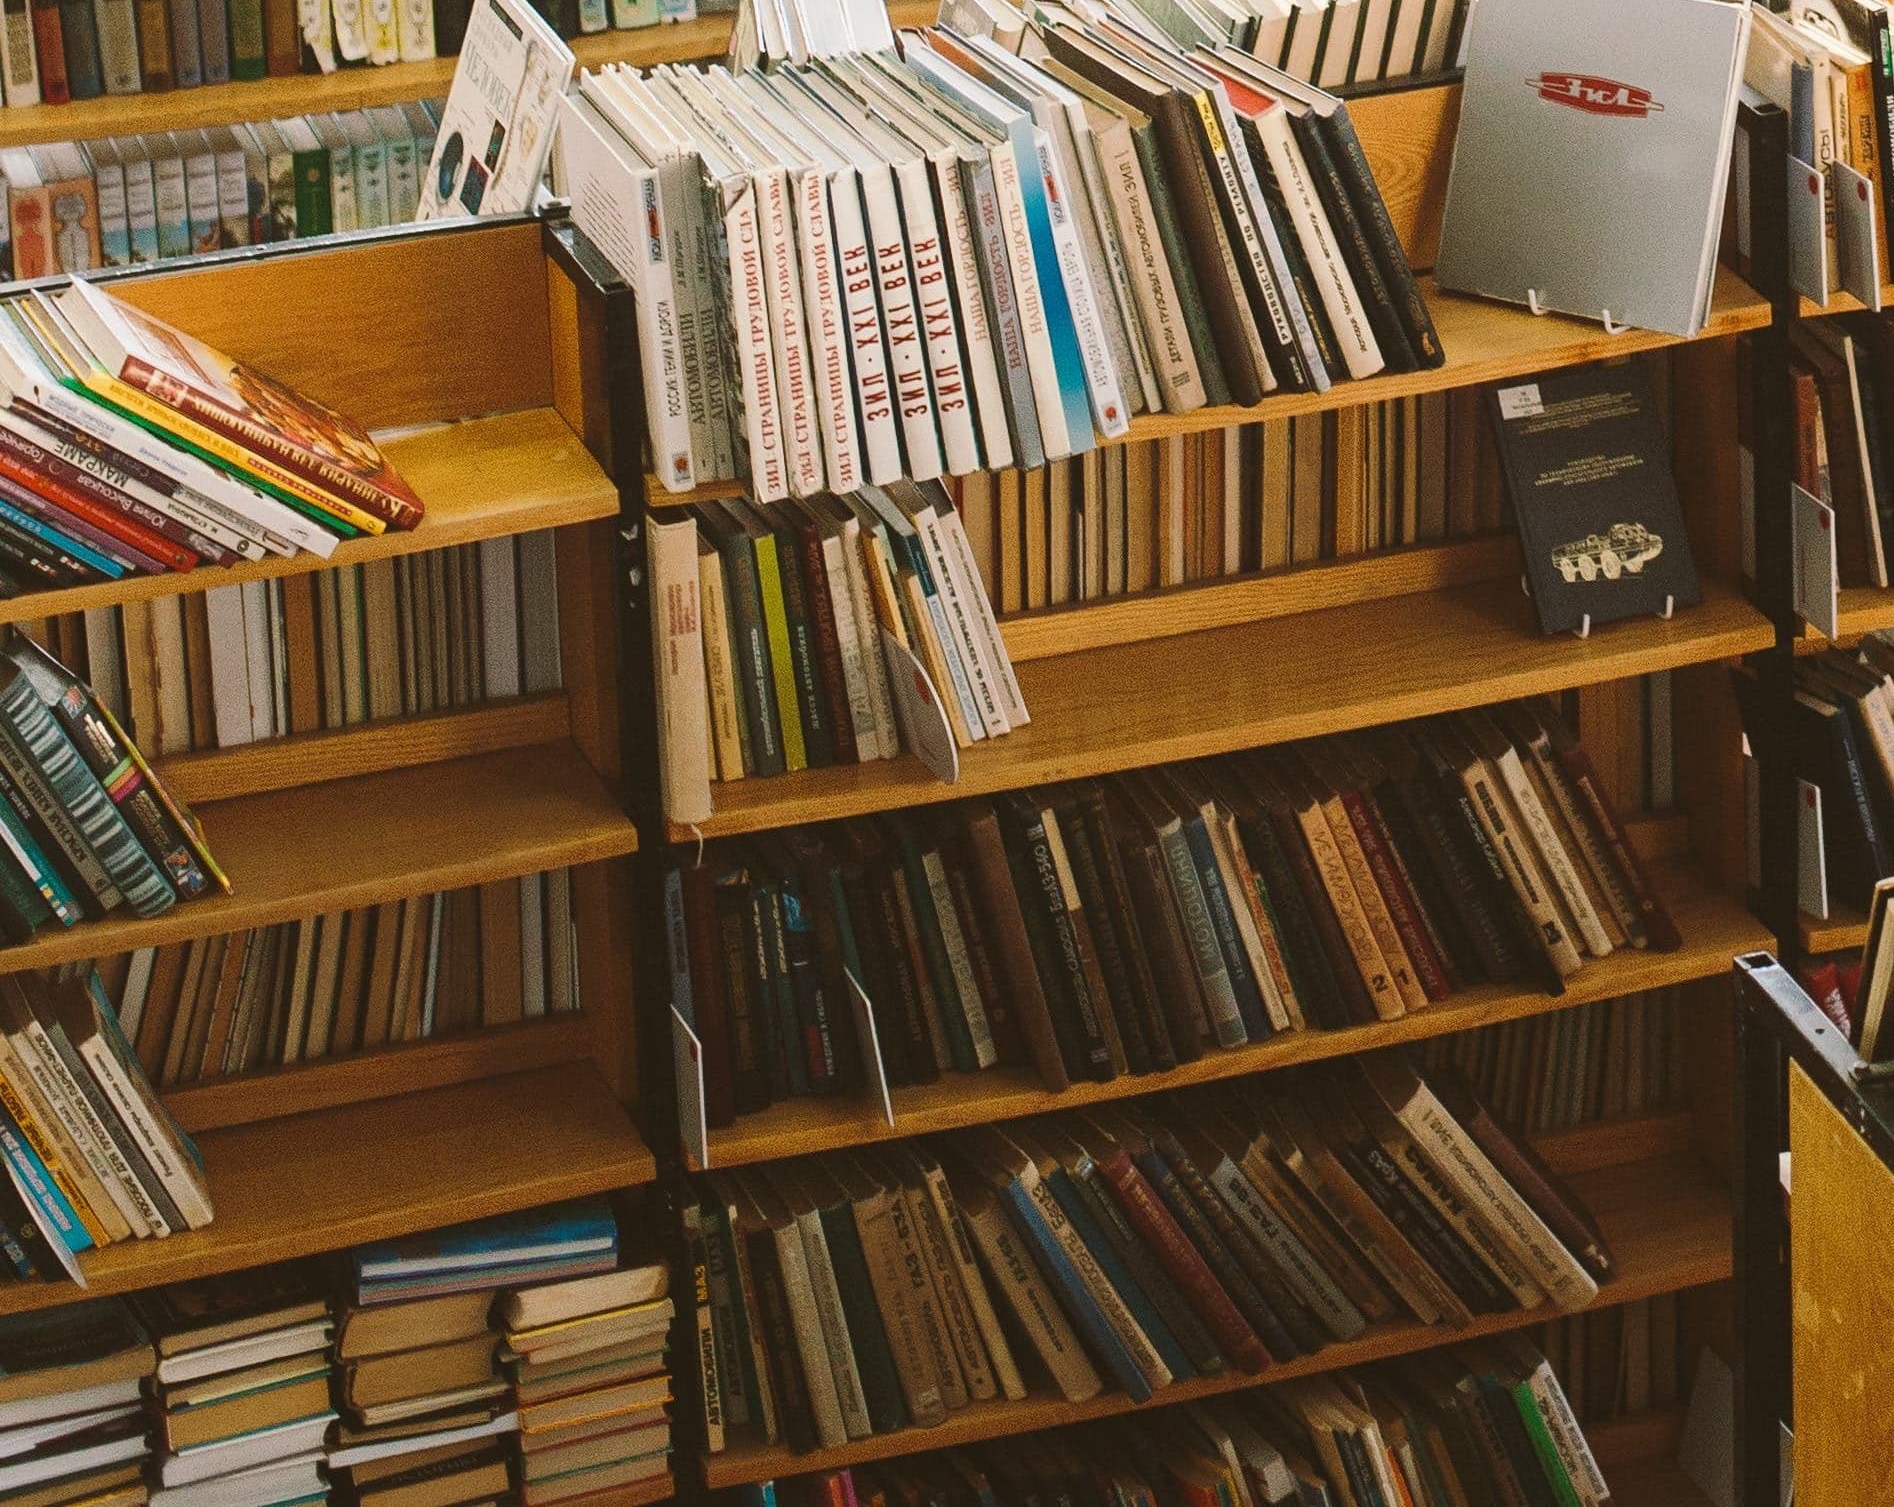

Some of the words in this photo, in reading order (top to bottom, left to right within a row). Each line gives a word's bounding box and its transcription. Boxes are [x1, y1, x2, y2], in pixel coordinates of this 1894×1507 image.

[1118, 161, 1137, 192] ЗИЛ
[1217, 154, 1245, 215] РЕМОНТУ
[806, 174, 825, 237] СЛАВЫ
[1127, 195, 1156, 268] АВТОМОБИЛЕЙ
[842, 245, 871, 291] ВЕК
[877, 242, 906, 288] ВЕК
[913, 238, 942, 284] ВЕК
[954, 209, 979, 289] ГОРДОСТЬ
[1006, 202, 1033, 281] ГОРДОСТЬ
[741, 249, 766, 347] ТРУДОВОЙ
[772, 242, 799, 339] ТРУДОВОЙ
[812, 243, 837, 339] ТРУДОВОЙ
[984, 233, 1013, 312] ГОРДОСТЬ
[1146, 270, 1170, 324] ГРУЗОВЫХ
[1250, 250, 1289, 341] РУКОВОДСТВО
[967, 292, 987, 341] НАША
[1022, 284, 1043, 334] НАША
[679, 312, 706, 426] АВТОМОБИЛИ
[697, 307, 727, 421] АВТОМОБИЛИ
[1000, 315, 1024, 369] НАША
[1162, 324, 1182, 363] ДЕТАЛИ
[753, 352, 775, 450] СТРАНИЦЫ
[785, 345, 809, 443] СТРАНИЦЫ
[825, 344, 849, 444] СТРАНИЦЫ
[861, 372, 889, 421] ЗИЛ
[897, 369, 927, 418] ЗИЛ
[933, 363, 964, 412] ЗИЛ
[189, 395, 291, 458] НАЧИНАЮЩИХ
[52, 433, 129, 492] МАКРАМЕ
[288, 449, 317, 471] ДЛЯ
[75, 470, 133, 511] Высоцкая
[130, 501, 166, 529] Юлия
[315, 461, 402, 517] КУЛИНАРИЯ
[1368, 973, 1389, 994] 2
[1395, 968, 1411, 987] 1
[72, 1094, 113, 1152] ПЛОТНИКОВ
[107, 1151, 127, 1175] ДЛЯ
[120, 1173, 155, 1219] ПОСОБИЕ
[693, 1264, 707, 1301] МАЗ
